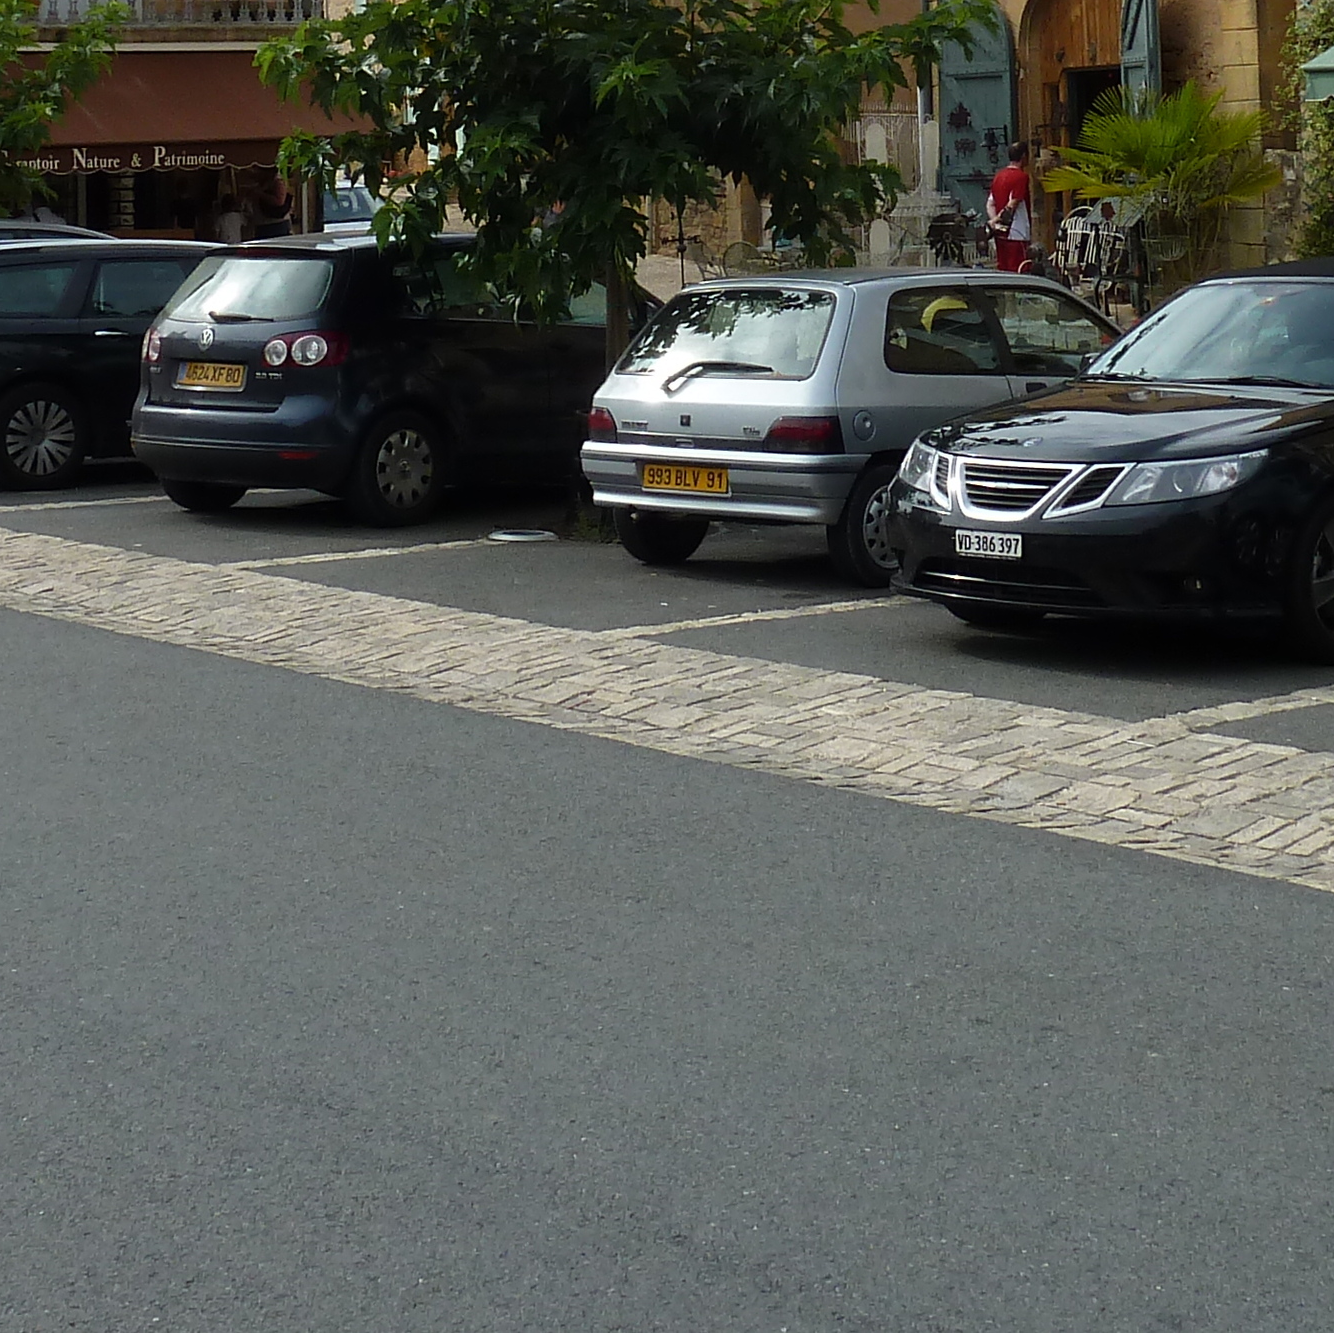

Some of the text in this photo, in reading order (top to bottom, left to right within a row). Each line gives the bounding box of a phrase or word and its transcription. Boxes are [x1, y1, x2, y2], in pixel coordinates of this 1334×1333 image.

[72, 148, 120, 169] Nature
[130, 152, 141, 167] &
[153, 145, 225, 167] Patrimoine
[210, 366, 225, 382] XF
[647, 468, 723, 489] 993 BLV 91
